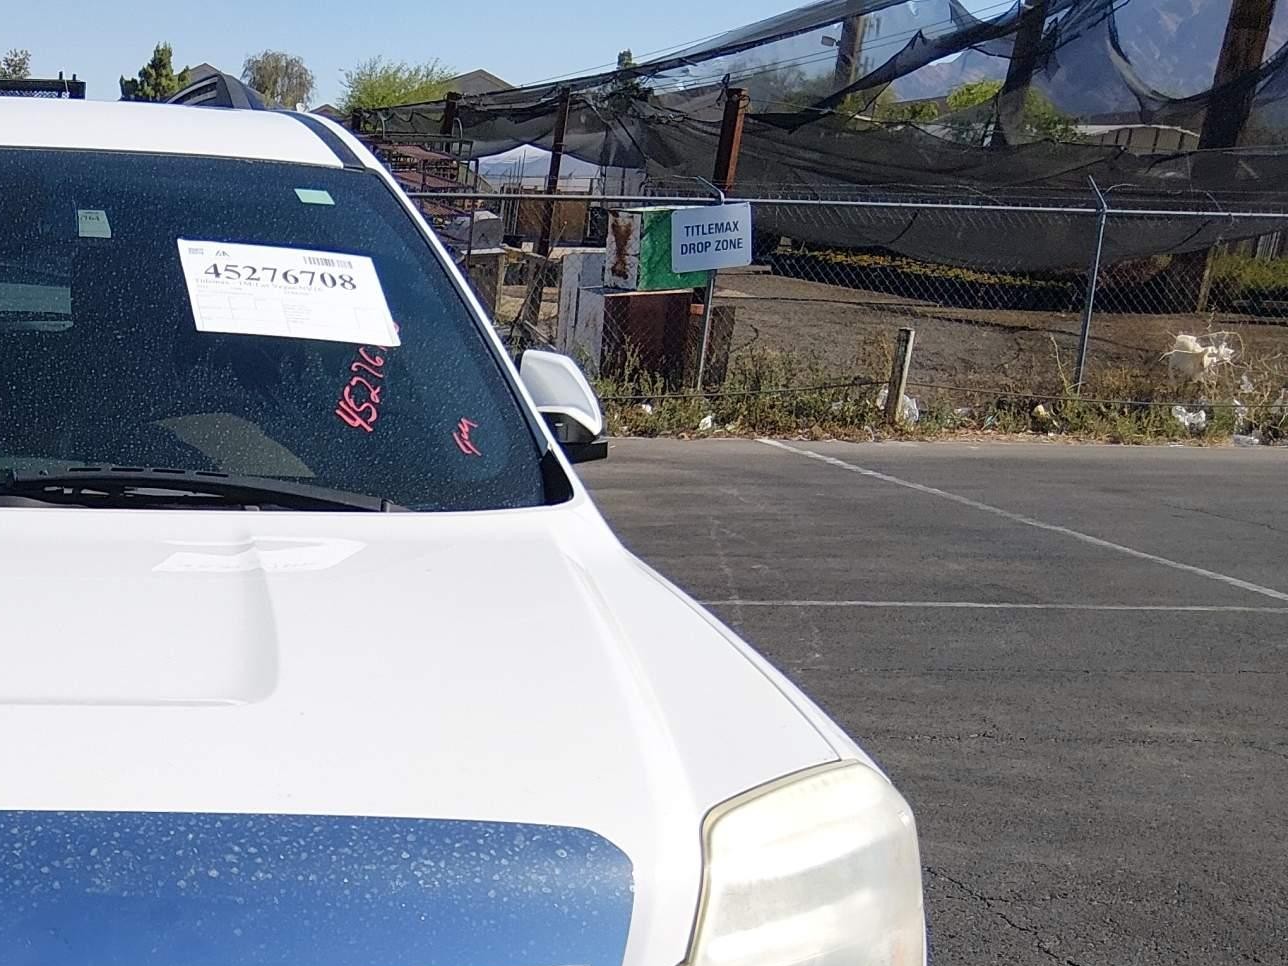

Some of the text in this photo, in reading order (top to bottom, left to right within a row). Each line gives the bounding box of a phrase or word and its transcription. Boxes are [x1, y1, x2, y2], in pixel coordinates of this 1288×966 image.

[684, 220, 739, 237] TITLEMAX
[680, 237, 744, 256] DROP ZONE
[203, 262, 358, 291] 45276708
[335, 322, 400, 432] 45276
